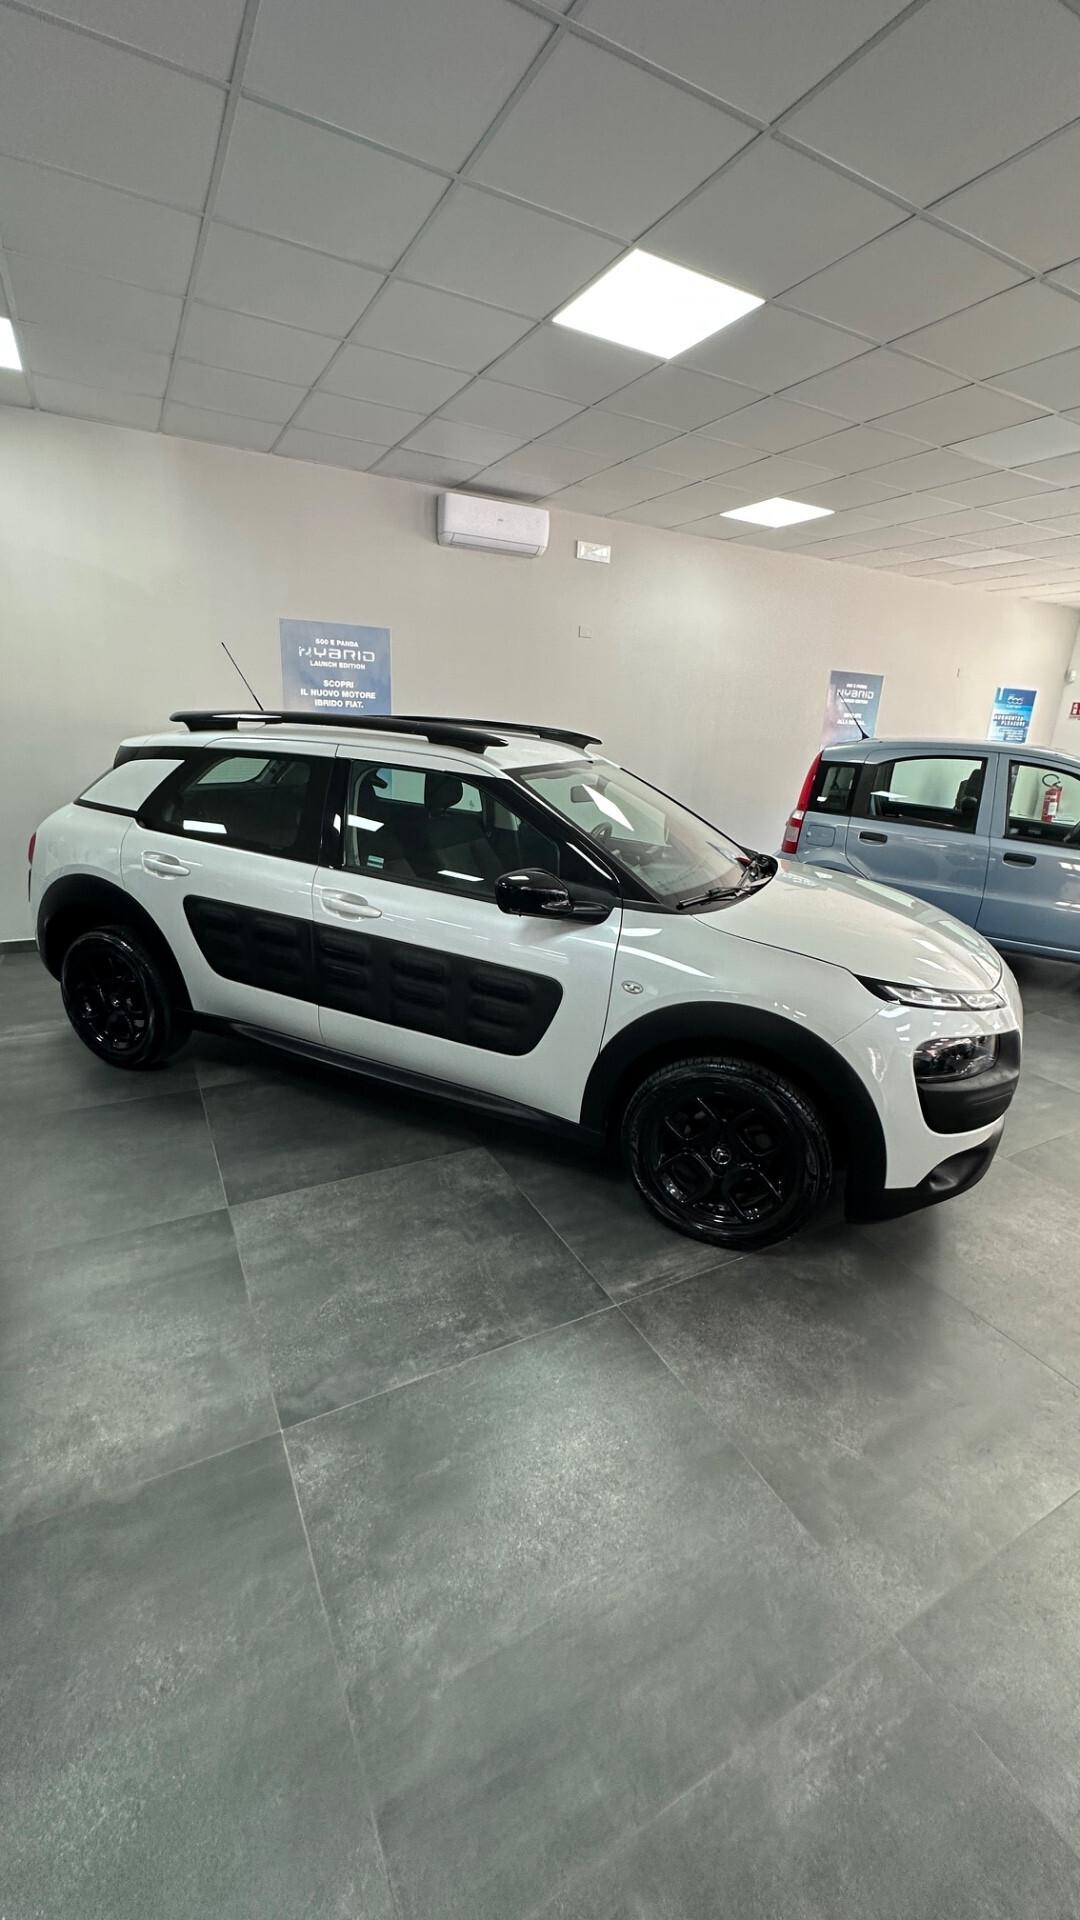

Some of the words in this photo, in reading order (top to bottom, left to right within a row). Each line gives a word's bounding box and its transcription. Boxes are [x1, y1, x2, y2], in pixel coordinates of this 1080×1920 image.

[310, 660, 337, 668] LAUNCH
[339, 661, 366, 670] EDITION
[323, 680, 354, 689] SCOPRI
[300, 688, 309, 696] IL
[310, 689, 340, 697] NUOVO
[341, 690, 376, 699] MOTORE
[314, 699, 343, 707] IBRIDO
[345, 700, 364, 709] FIAT.
